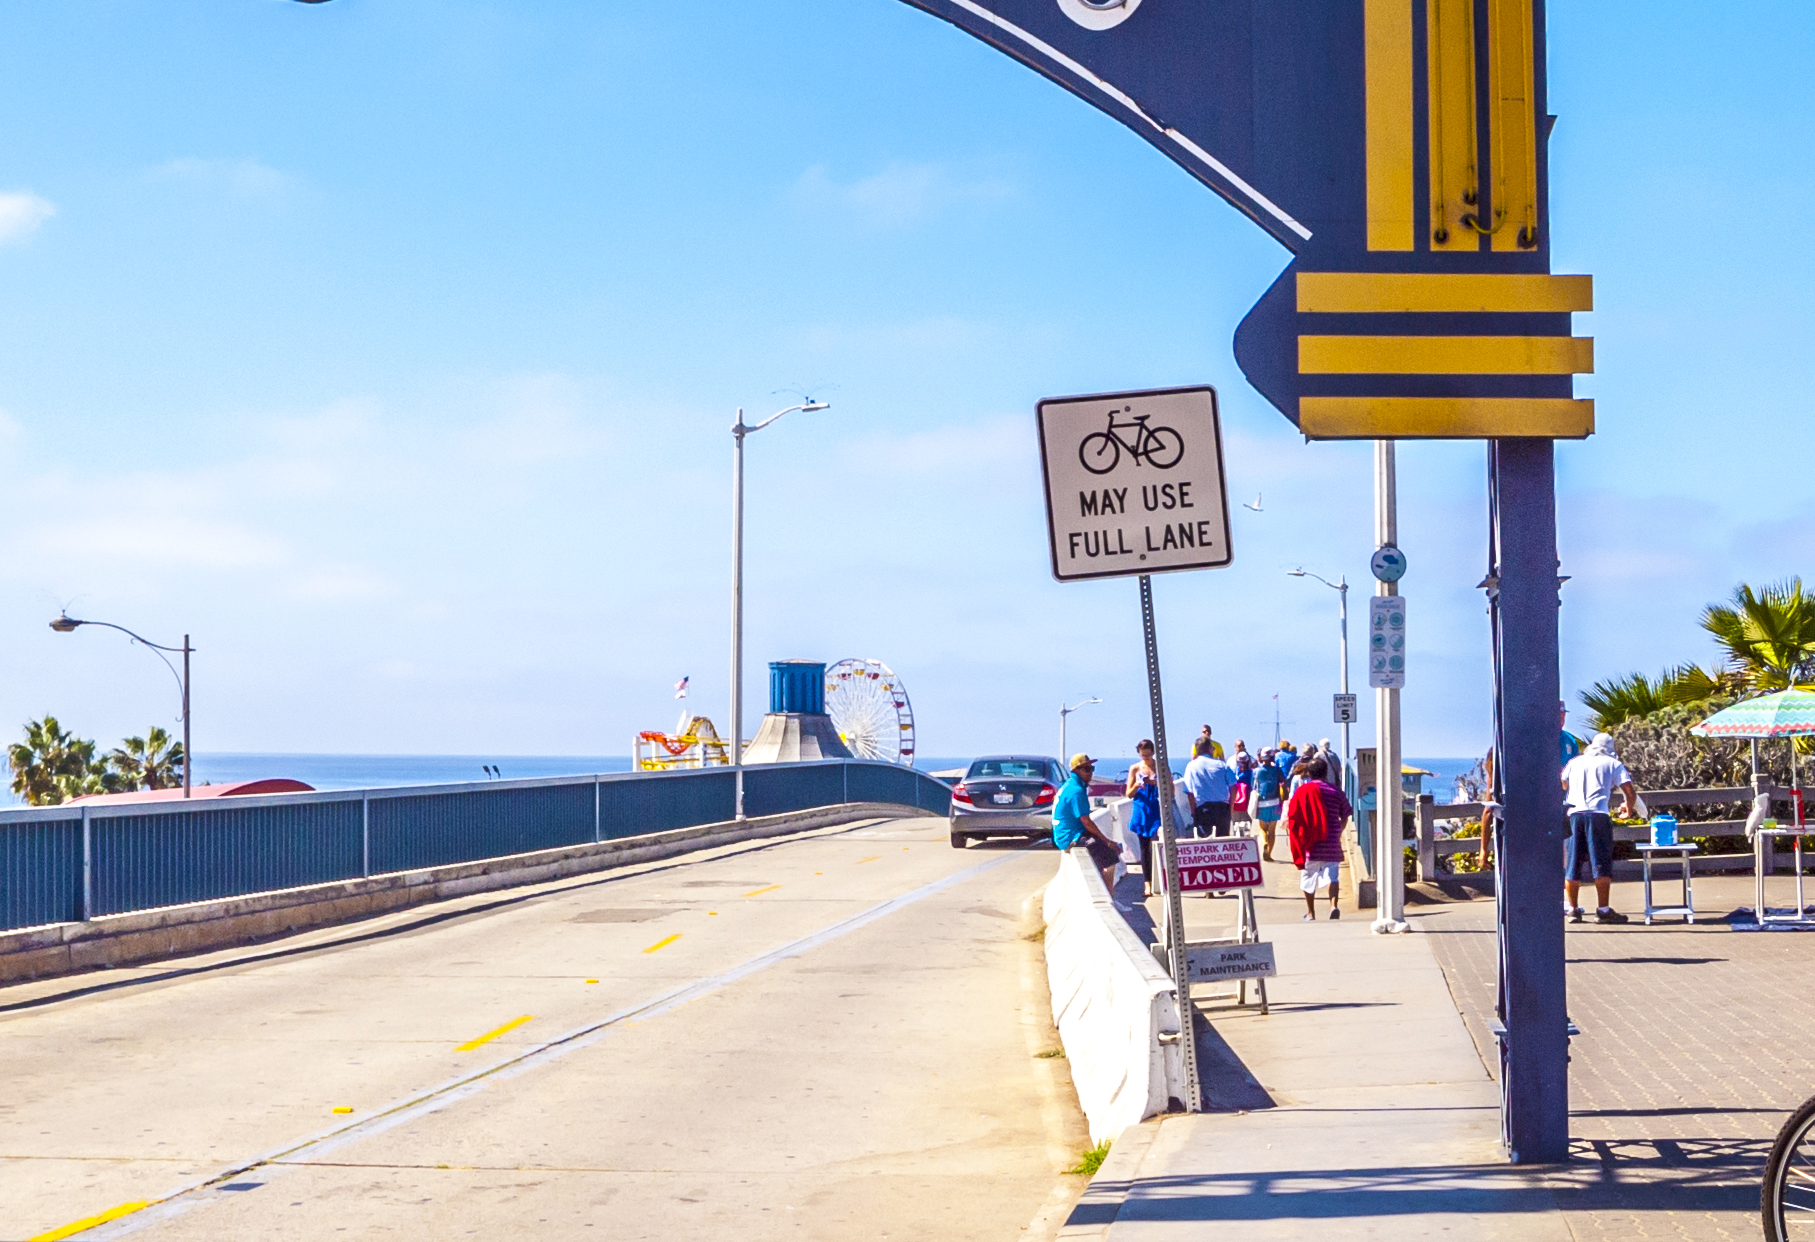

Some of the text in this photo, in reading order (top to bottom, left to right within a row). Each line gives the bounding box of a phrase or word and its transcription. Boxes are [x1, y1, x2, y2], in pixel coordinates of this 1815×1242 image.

[1079, 482, 1194, 517] MAY USE
[1069, 521, 1212, 558] FULL LANE
[1341, 709, 1350, 720] 5
[1177, 842, 1248, 855] HIS PARK AREA
[1178, 853, 1244, 865] TEMPORARILY
[1179, 866, 1259, 886] LOSED
[1220, 953, 1247, 962] PARK
[1200, 962, 1271, 976] MAINTENANCE
